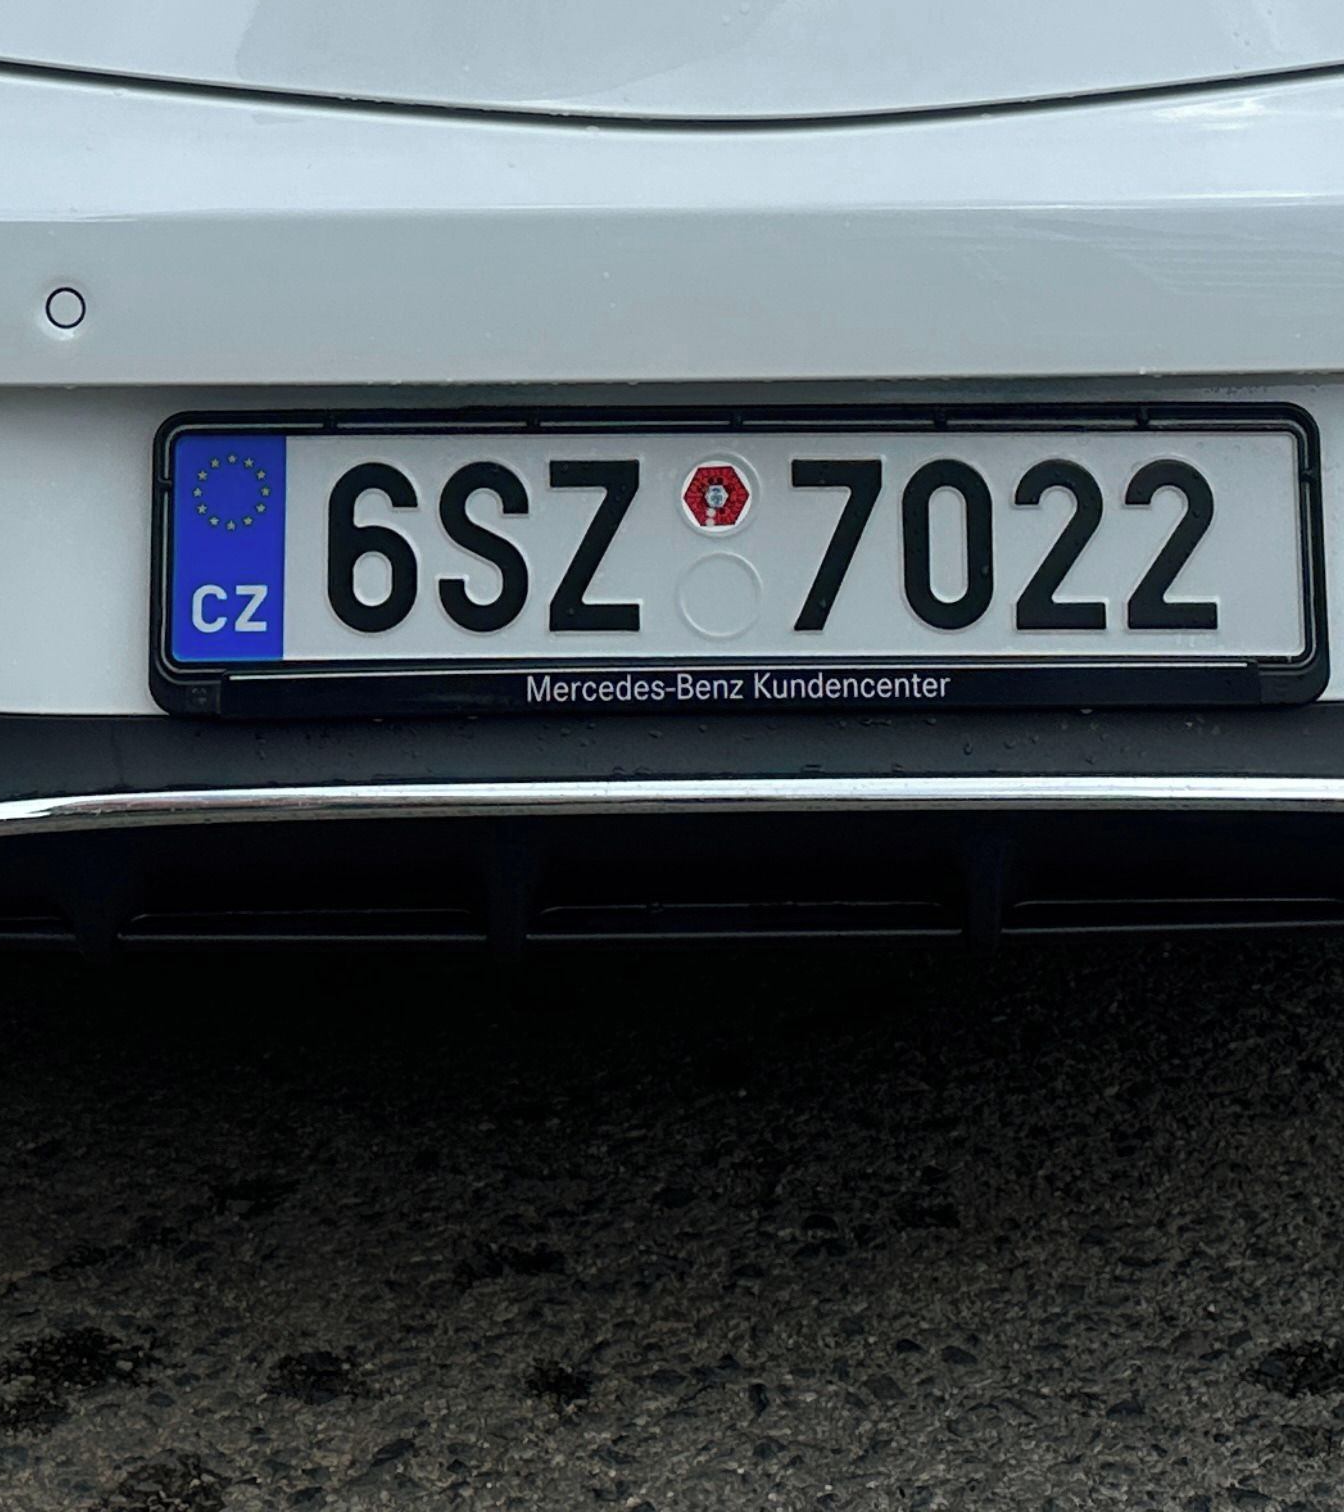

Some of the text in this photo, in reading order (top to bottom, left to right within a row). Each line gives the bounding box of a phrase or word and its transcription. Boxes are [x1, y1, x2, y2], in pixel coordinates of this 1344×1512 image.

[326, 458, 1218, 635] 6SZ 7022
[191, 584, 268, 634] CZ
[526, 672, 951, 703] Mercedes-Benz Kundencenter
